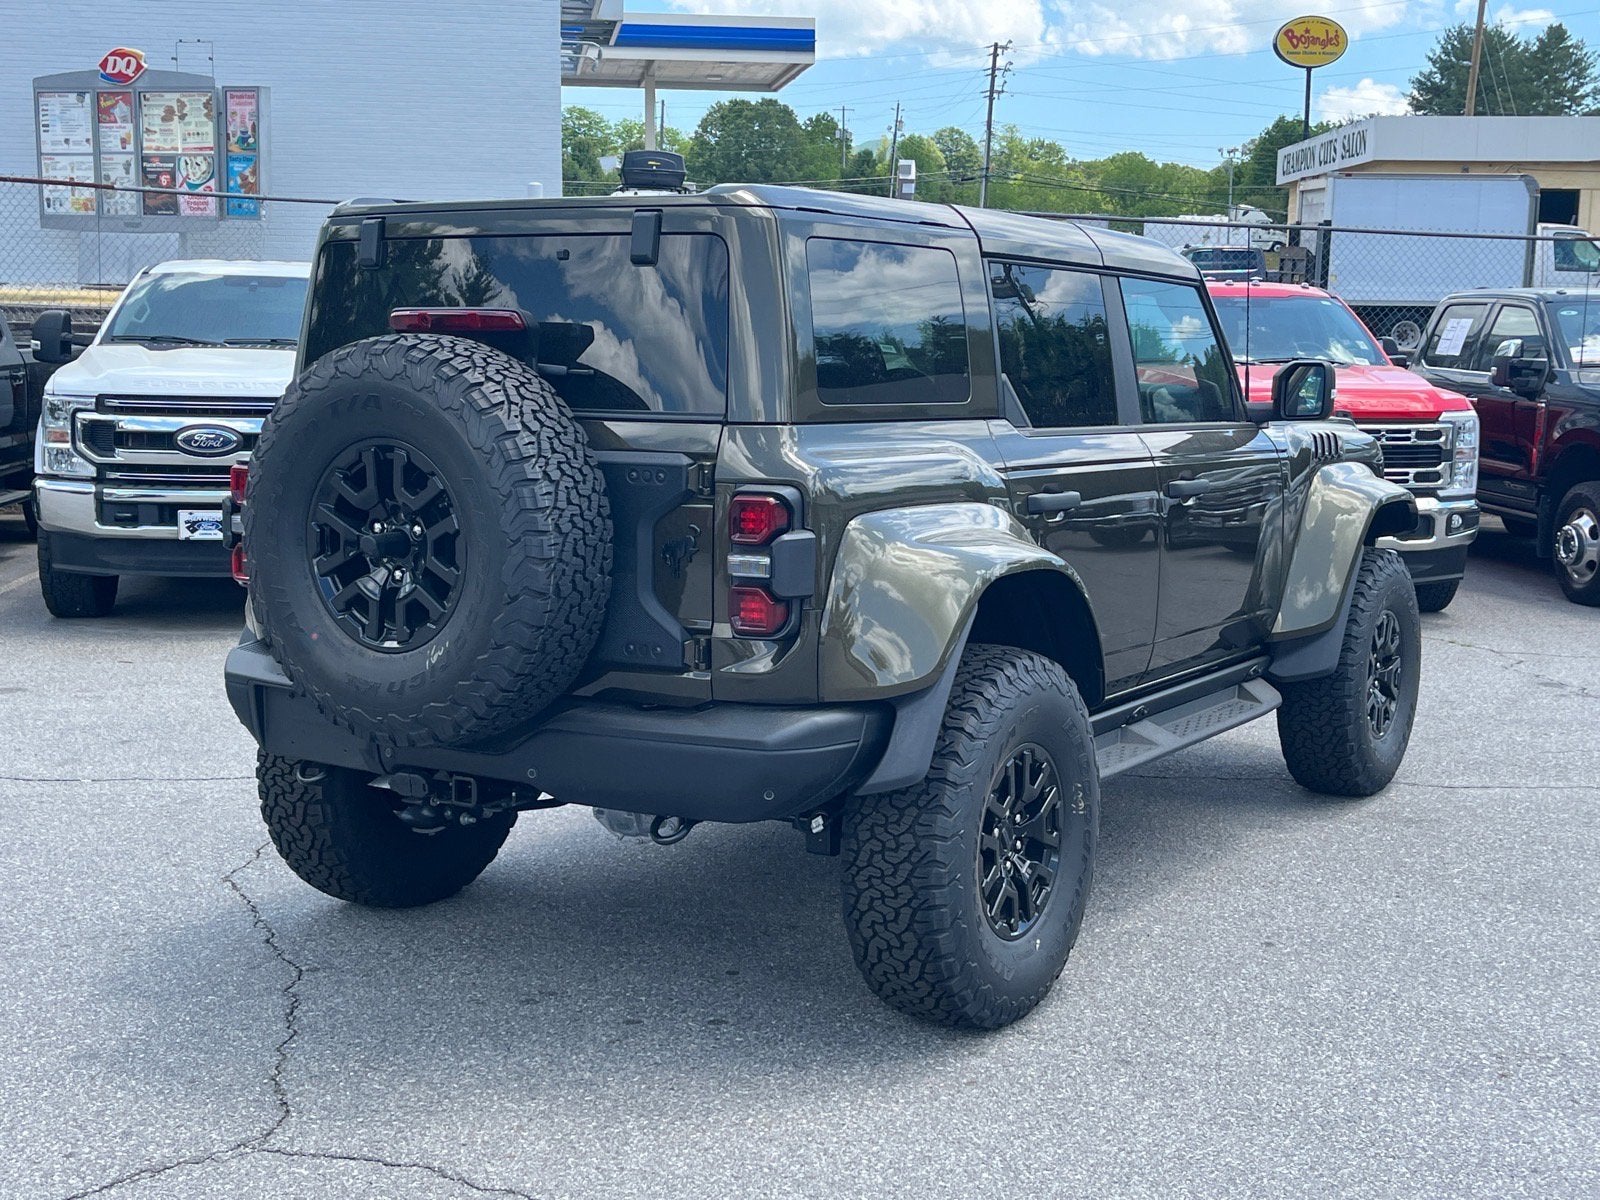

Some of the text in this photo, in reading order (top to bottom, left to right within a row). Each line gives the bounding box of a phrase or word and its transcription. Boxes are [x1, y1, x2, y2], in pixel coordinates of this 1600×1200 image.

[106, 56, 137, 77] DQ
[1282, 129, 1368, 177] CHAMPION CUTS SALON
[191, 433, 223, 448] Ford
